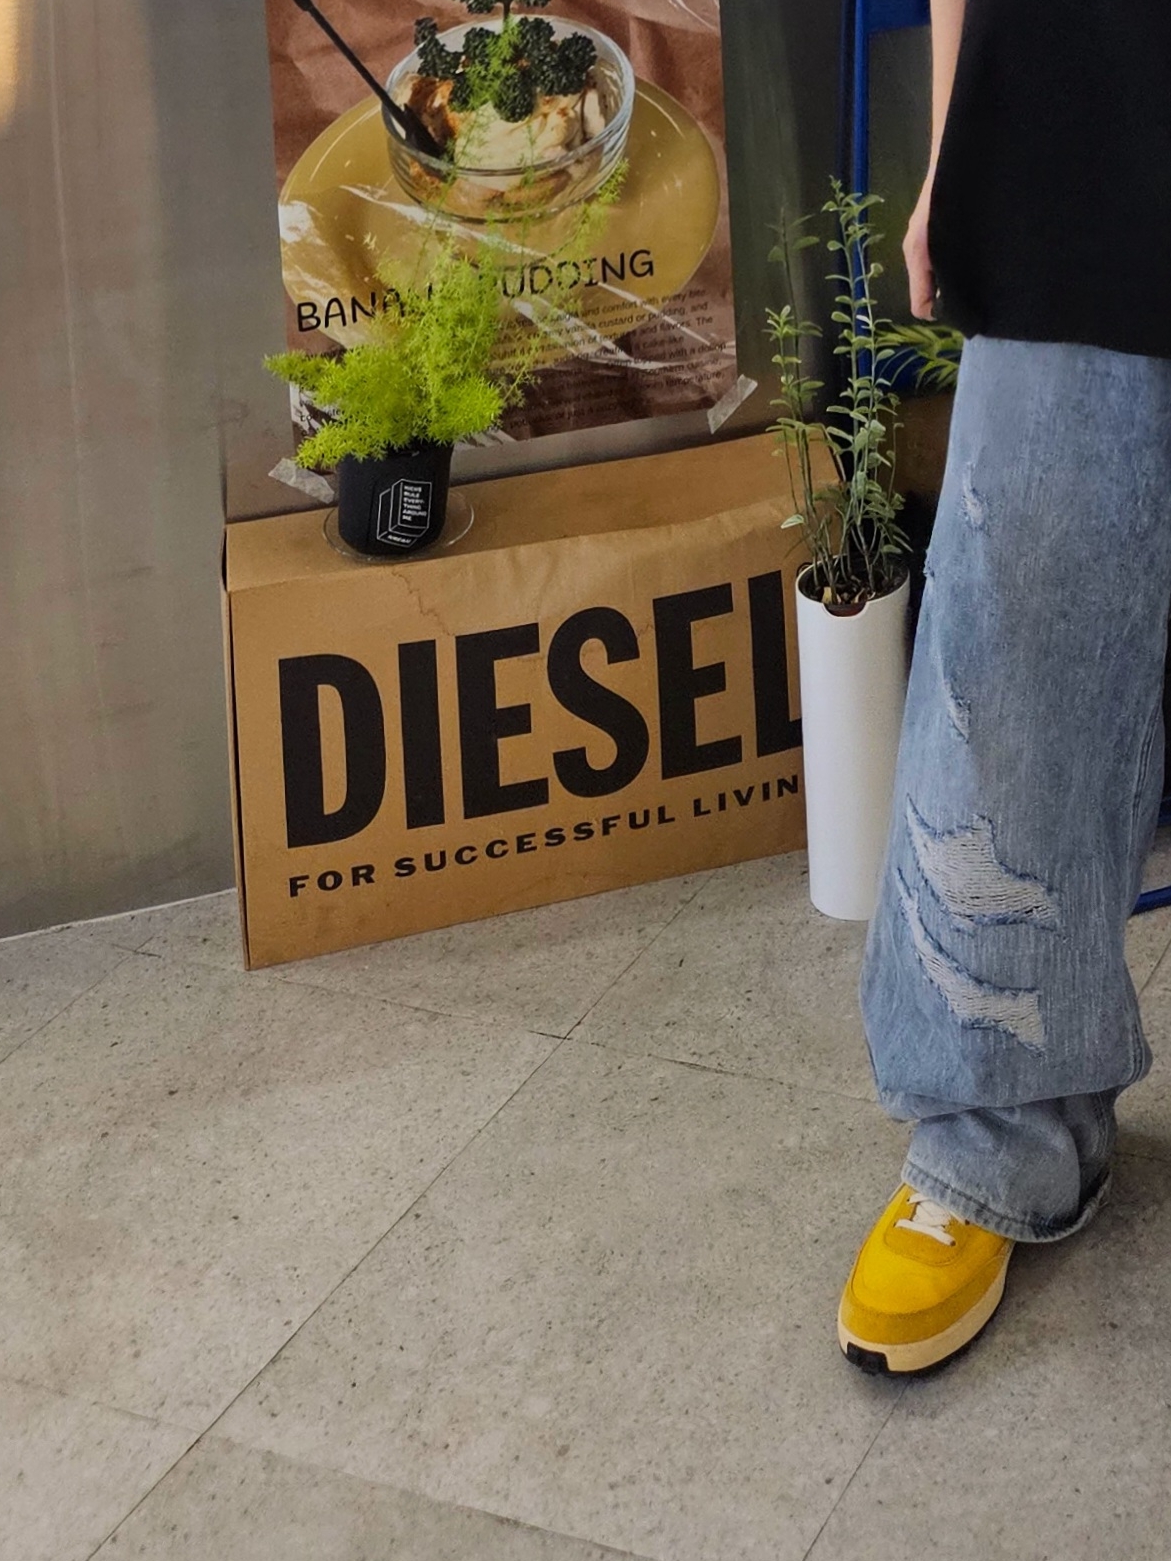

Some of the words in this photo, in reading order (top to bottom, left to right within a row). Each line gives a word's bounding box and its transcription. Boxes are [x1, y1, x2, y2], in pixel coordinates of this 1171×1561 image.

[599, 315, 633, 330] custard
[695, 316, 713, 328] The
[278, 569, 803, 849] DIESEL
[289, 863, 376, 898] FOR
[393, 804, 677, 879] SUCCESSFUL
